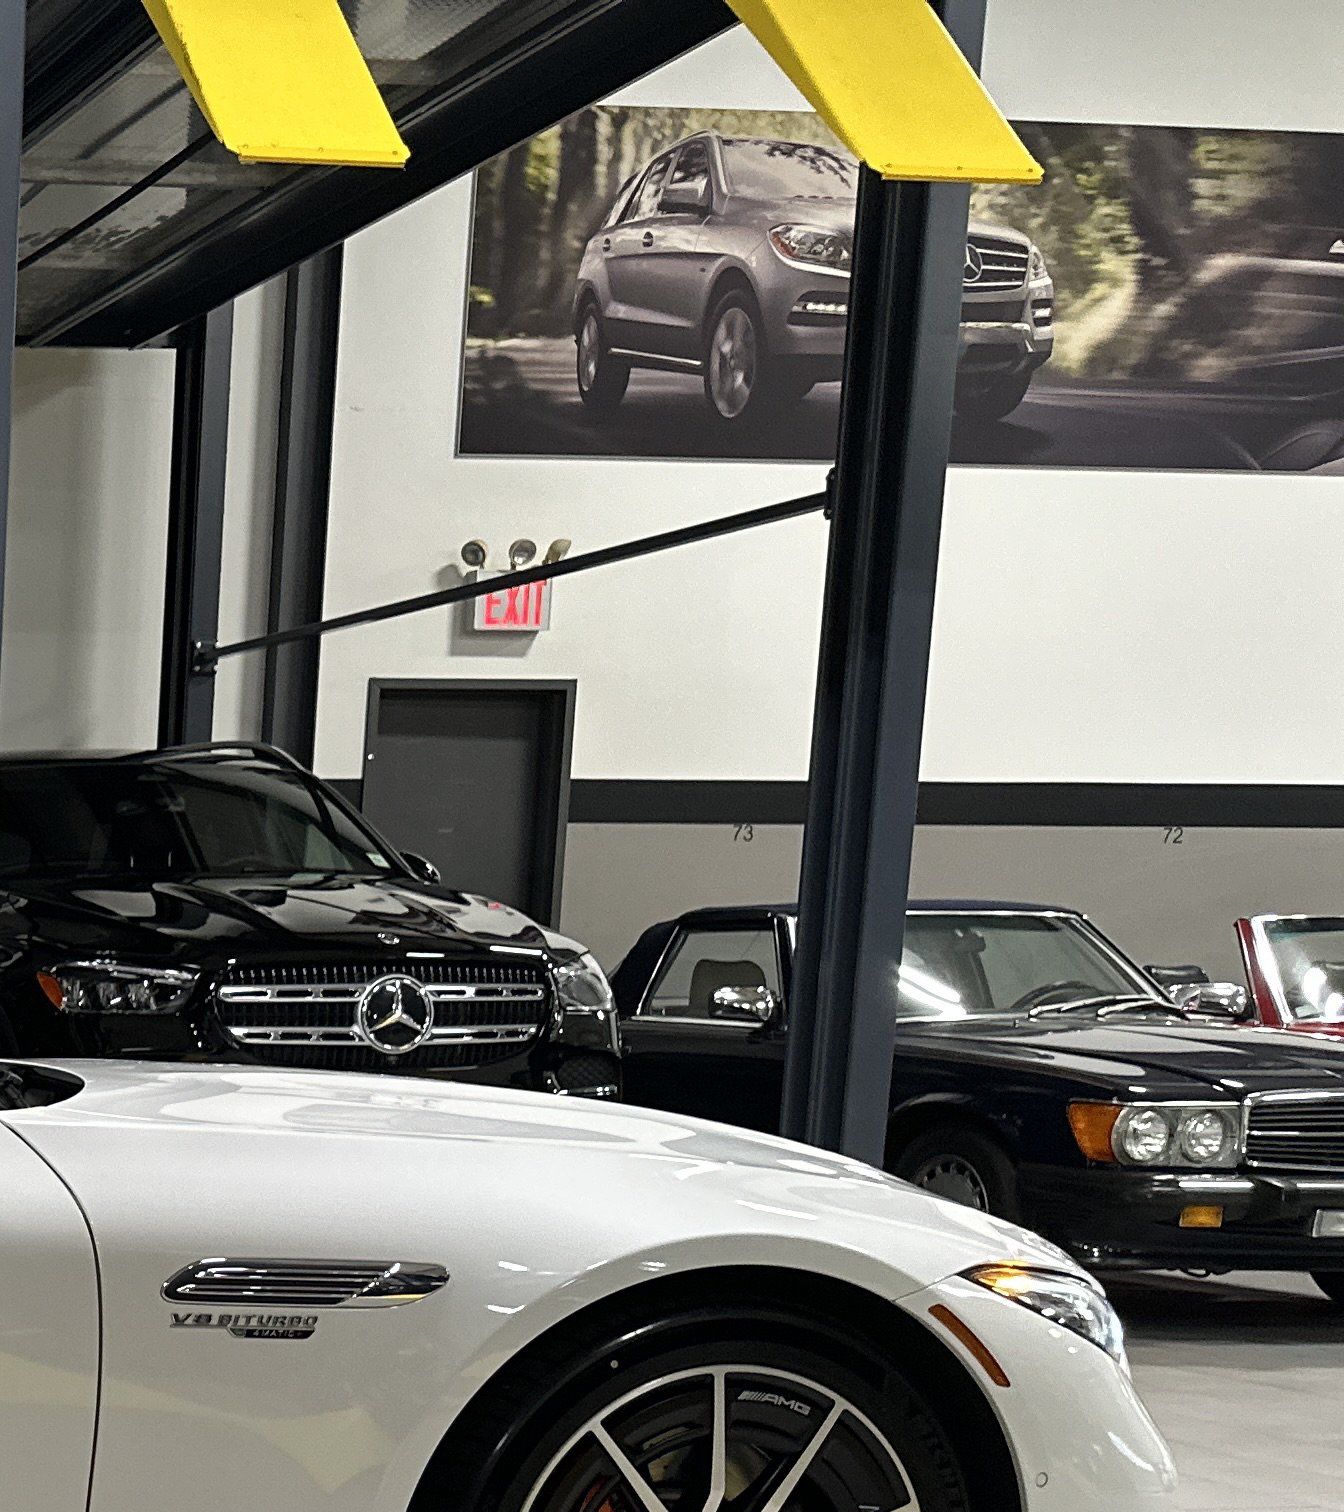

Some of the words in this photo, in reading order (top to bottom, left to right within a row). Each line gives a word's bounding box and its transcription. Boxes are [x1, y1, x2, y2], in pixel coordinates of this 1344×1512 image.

[483, 579, 548, 627] EXIT
[732, 823, 755, 843] 73
[1162, 826, 1184, 845] 72
[170, 1312, 213, 1327] V8
[217, 1313, 319, 1328] BITURBO
